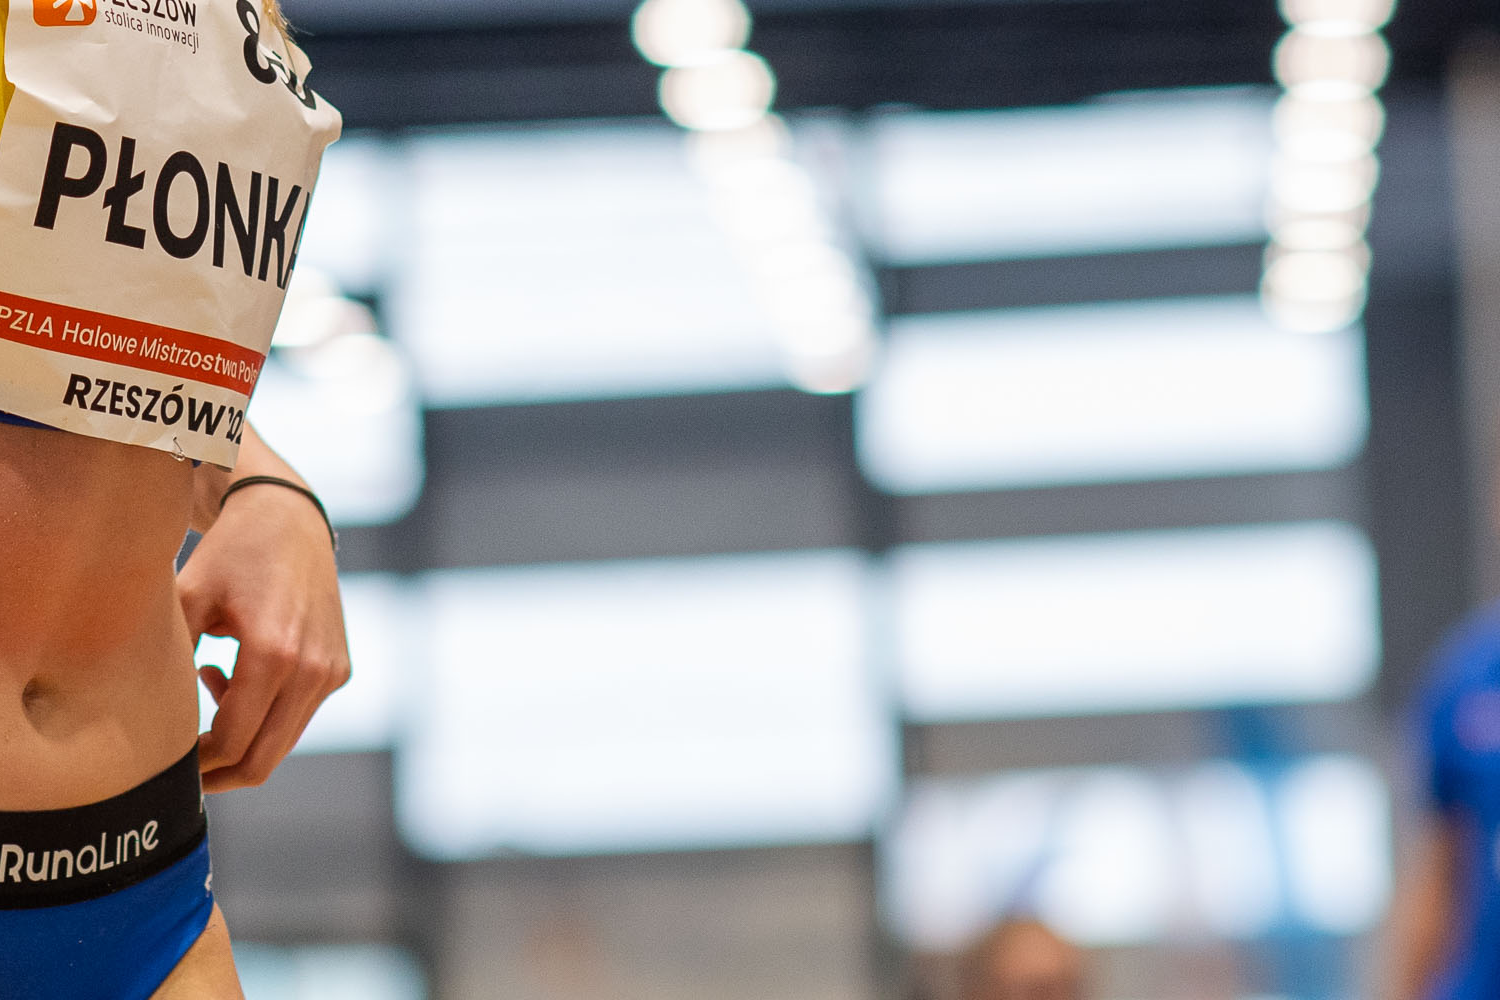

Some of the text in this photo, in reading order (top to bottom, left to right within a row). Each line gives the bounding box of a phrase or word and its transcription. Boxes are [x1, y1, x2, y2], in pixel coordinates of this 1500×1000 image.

[104, 8, 200, 55] stolica innowacji
[61, 319, 138, 354] Halowe
[139, 336, 238, 380] Mistrzostwa
[62, 373, 226, 436] RZESZÓW
